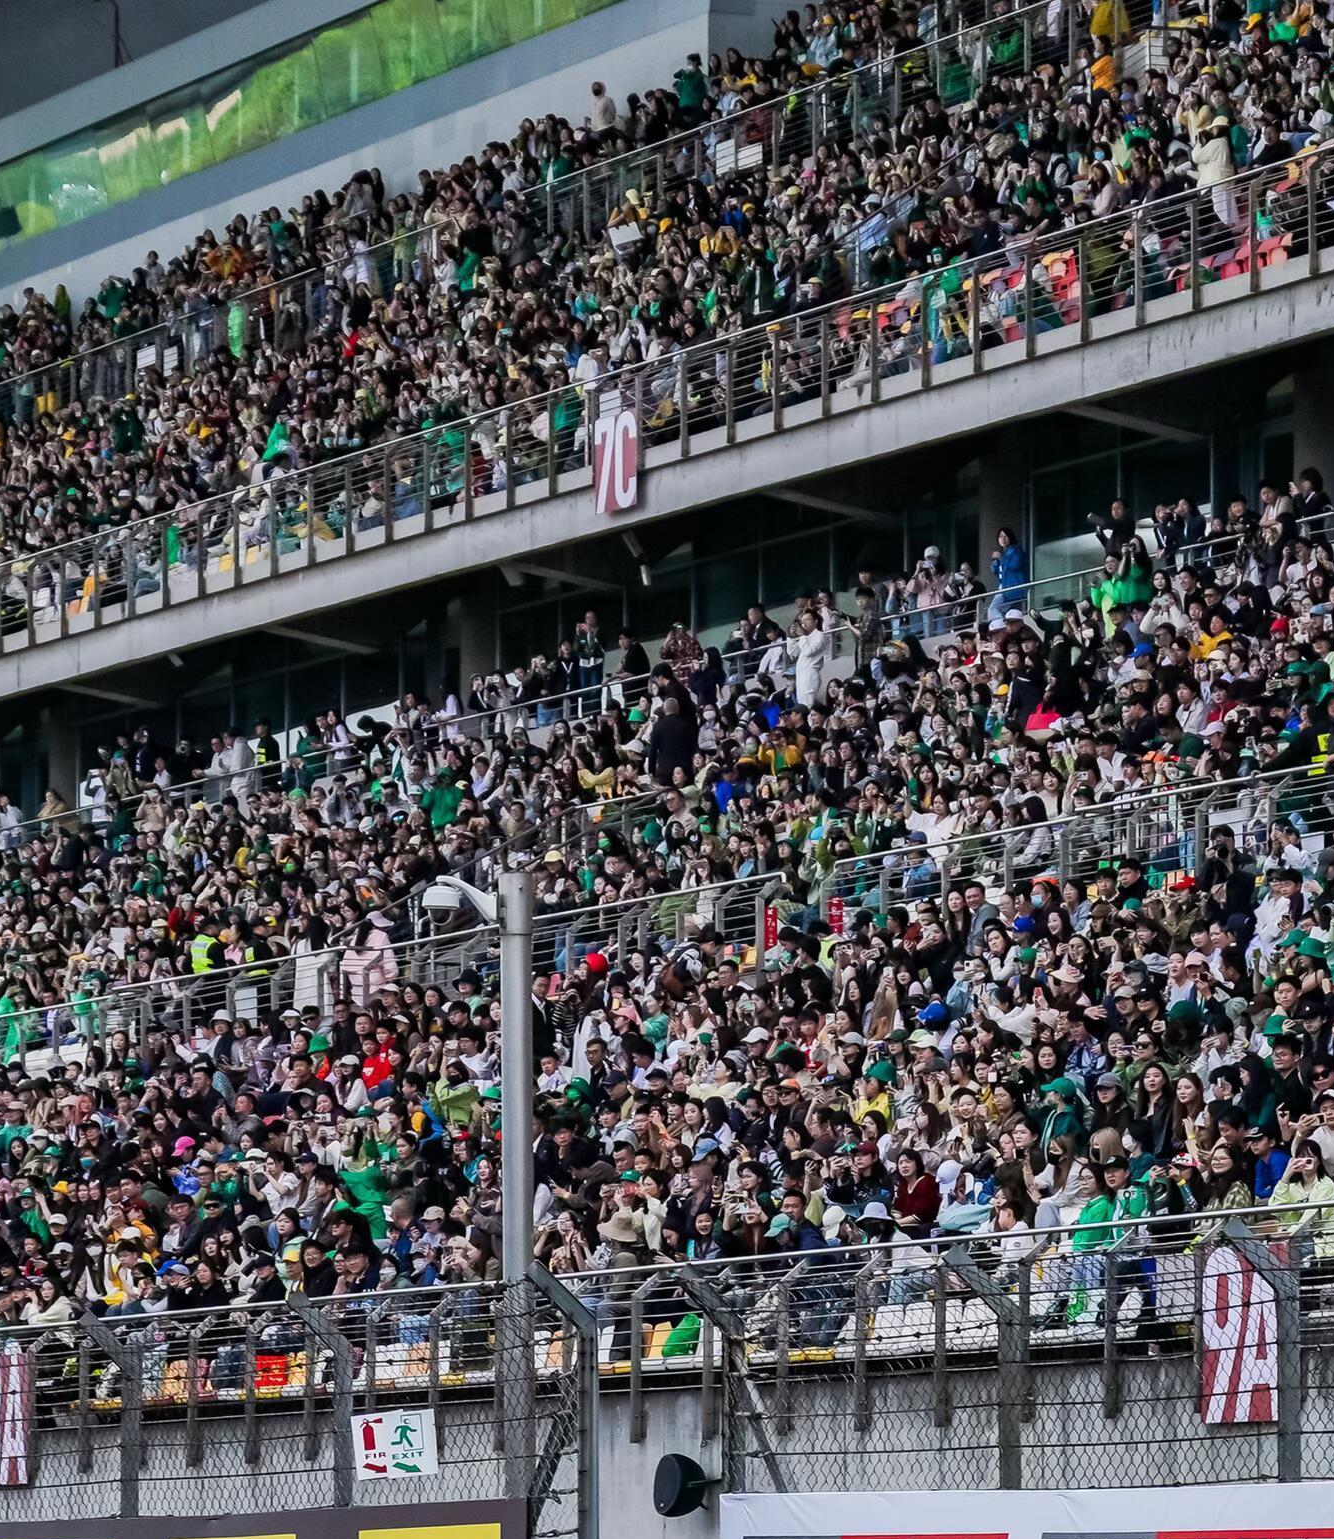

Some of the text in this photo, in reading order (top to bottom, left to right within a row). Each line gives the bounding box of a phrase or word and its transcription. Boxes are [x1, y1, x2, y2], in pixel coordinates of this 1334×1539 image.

[595, 411, 637, 513] 7C
[1201, 1247, 1278, 1423] 9A
[392, 1451, 424, 1459] EXIT
